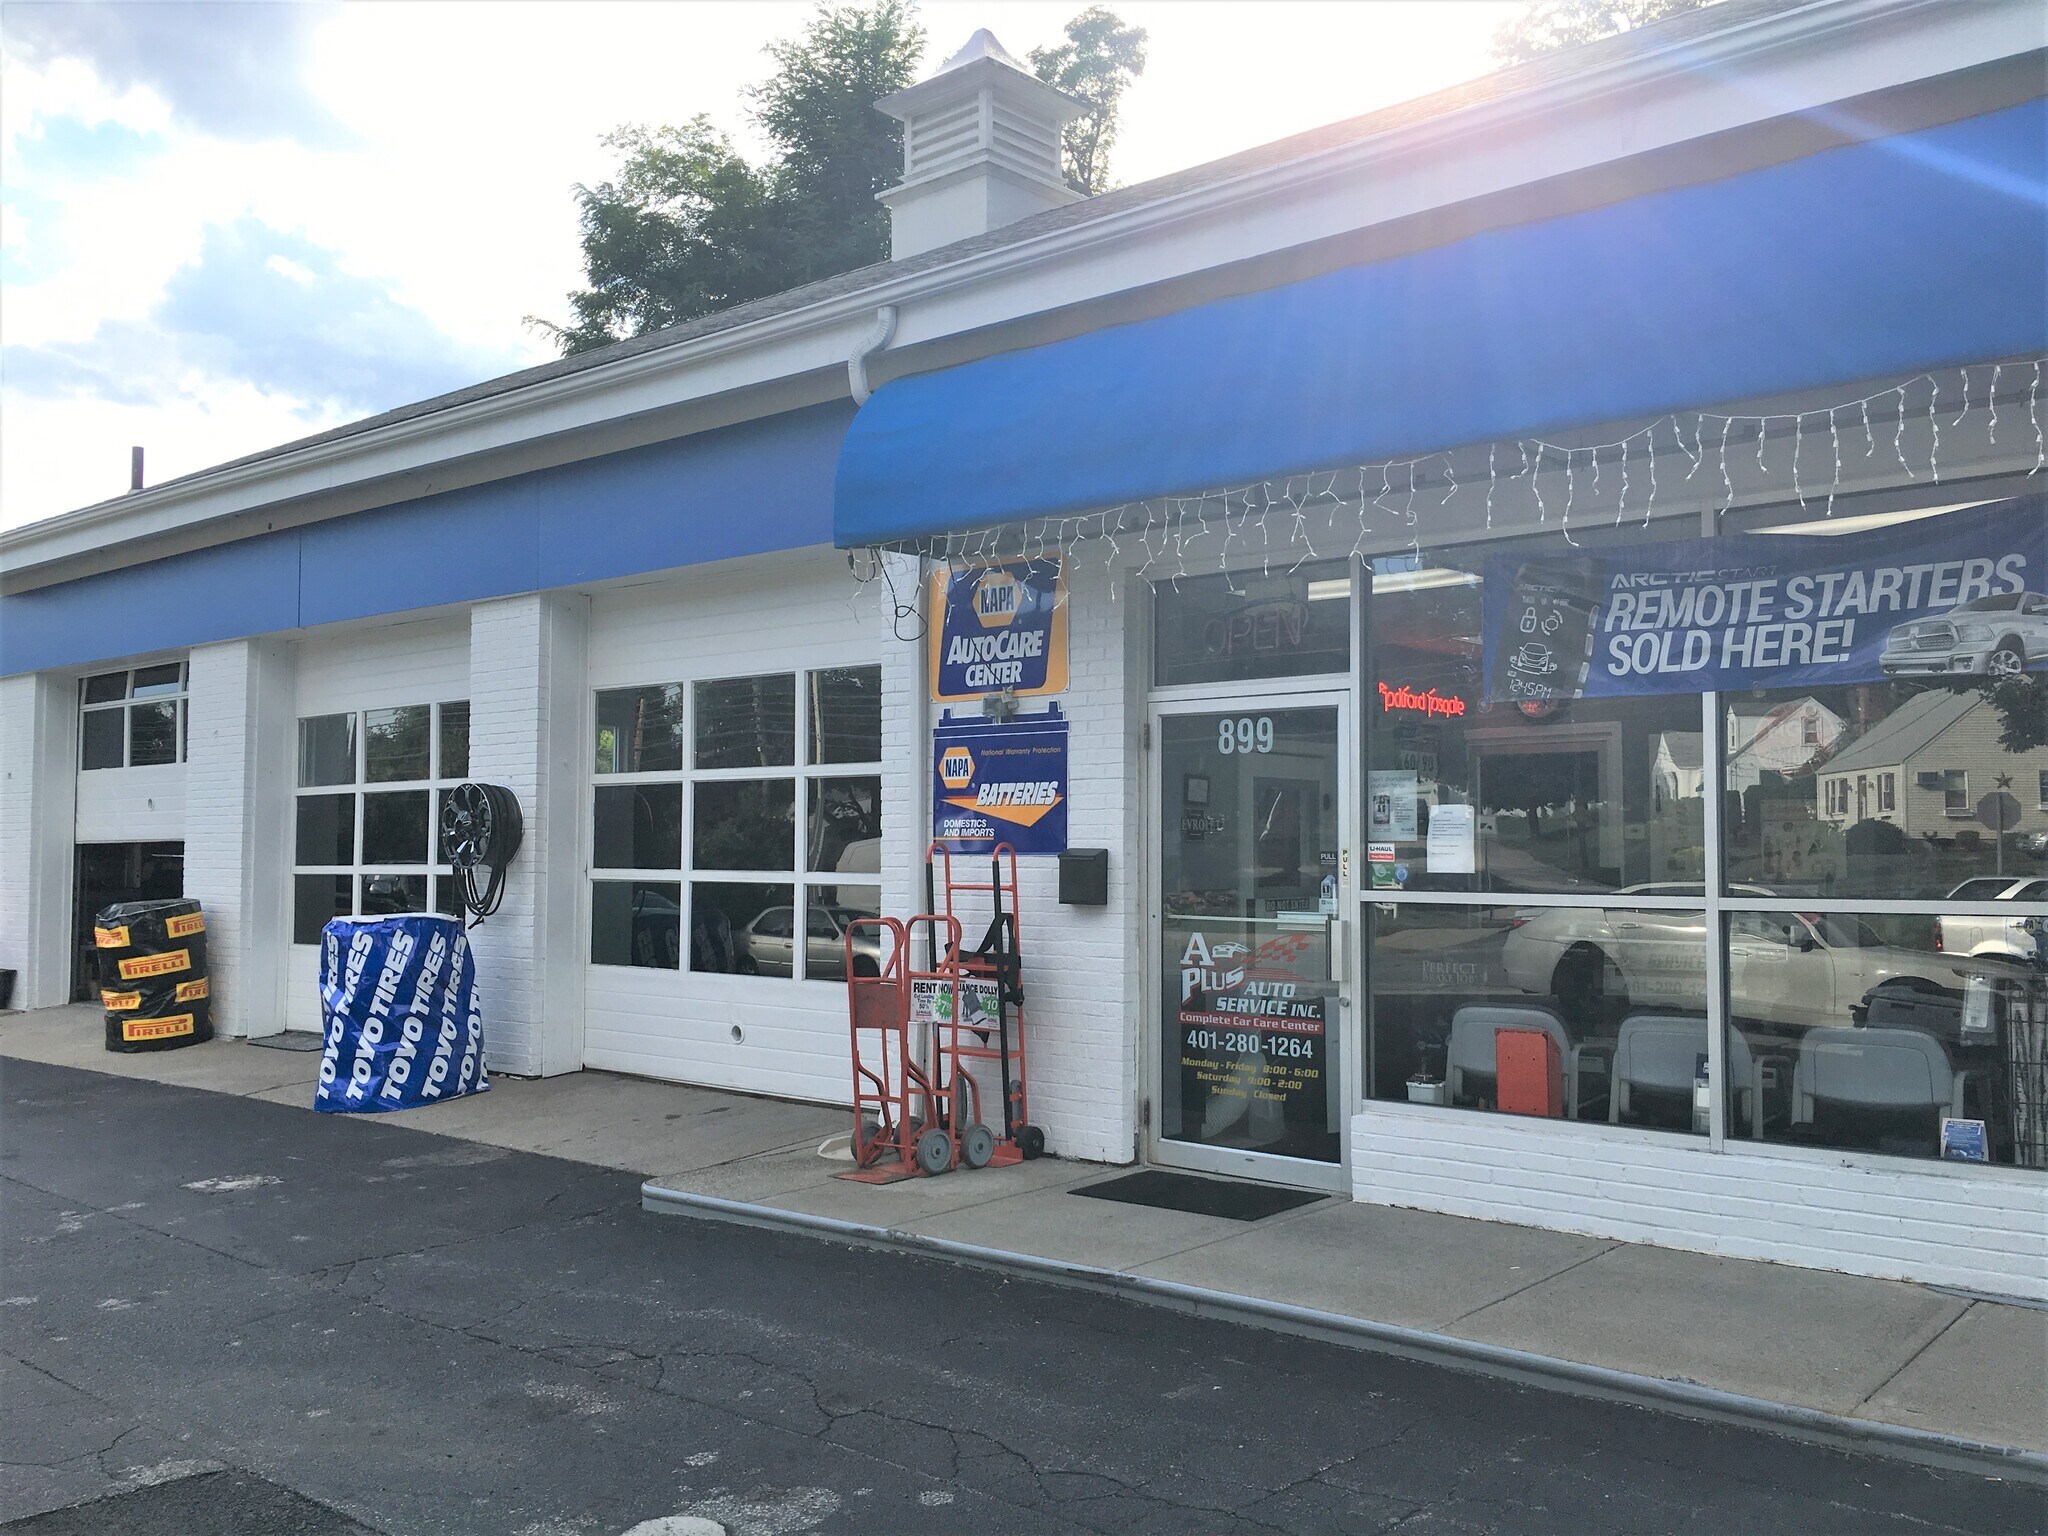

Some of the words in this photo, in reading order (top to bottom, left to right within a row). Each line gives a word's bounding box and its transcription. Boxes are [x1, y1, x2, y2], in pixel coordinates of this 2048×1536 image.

[980, 586, 1015, 614] NAPA
[1604, 579, 1777, 632] REMOTE
[1784, 554, 2027, 620] STARTERS
[1204, 605, 1302, 655] OPEN
[1607, 630, 1712, 676] SOLD
[1720, 618, 1855, 668] HERE!
[965, 661, 1022, 687] CENTER
[1218, 717, 1274, 754] 899
[1005, 747, 1030, 756] Warranty
[1032, 746, 1061, 755] Protection
[945, 757, 969, 778] NAPA
[976, 781, 1058, 807] BATTERIES
[943, 819, 987, 829] DOMESTICS
[943, 829, 960, 837] AND
[960, 827, 995, 837] IMPORTS
[1180, 932, 1215, 966] A
[124, 954, 184, 975] PIRELLI
[913, 983, 937, 993] RENT
[979, 985, 998, 994] DOLLY
[1244, 981, 1296, 997] AUTO
[346, 1016, 384, 1100] TOYO
[369, 929, 414, 1016] TIRES
[380, 1016, 424, 1100] TOYO
[410, 931, 446, 1016] TIRES
[421, 1016, 457, 1098] TOYO
[442, 933, 467, 1015] TIRES
[1216, 997, 1287, 1015] SERVICE
[1291, 1004, 1321, 1018] INC.
[128, 1018, 188, 1036] PIRELLI
[1180, 1012, 1231, 1026] Complete
[1233, 1016, 1251, 1026] Car
[1253, 1017, 1279, 1029] Care
[1281, 1020, 1320, 1032] Center
[457, 1014, 481, 1094] TOYO
[1187, 1029, 1313, 1058] 401-280-1264
[317, 1016, 344, 1099] TOYO
[1181, 1057, 1219, 1069] Monday
[1226, 1061, 1256, 1073] Friday
[1196, 1071, 1241, 1084] Saturday
[1211, 1085, 1247, 1098] Sunday
